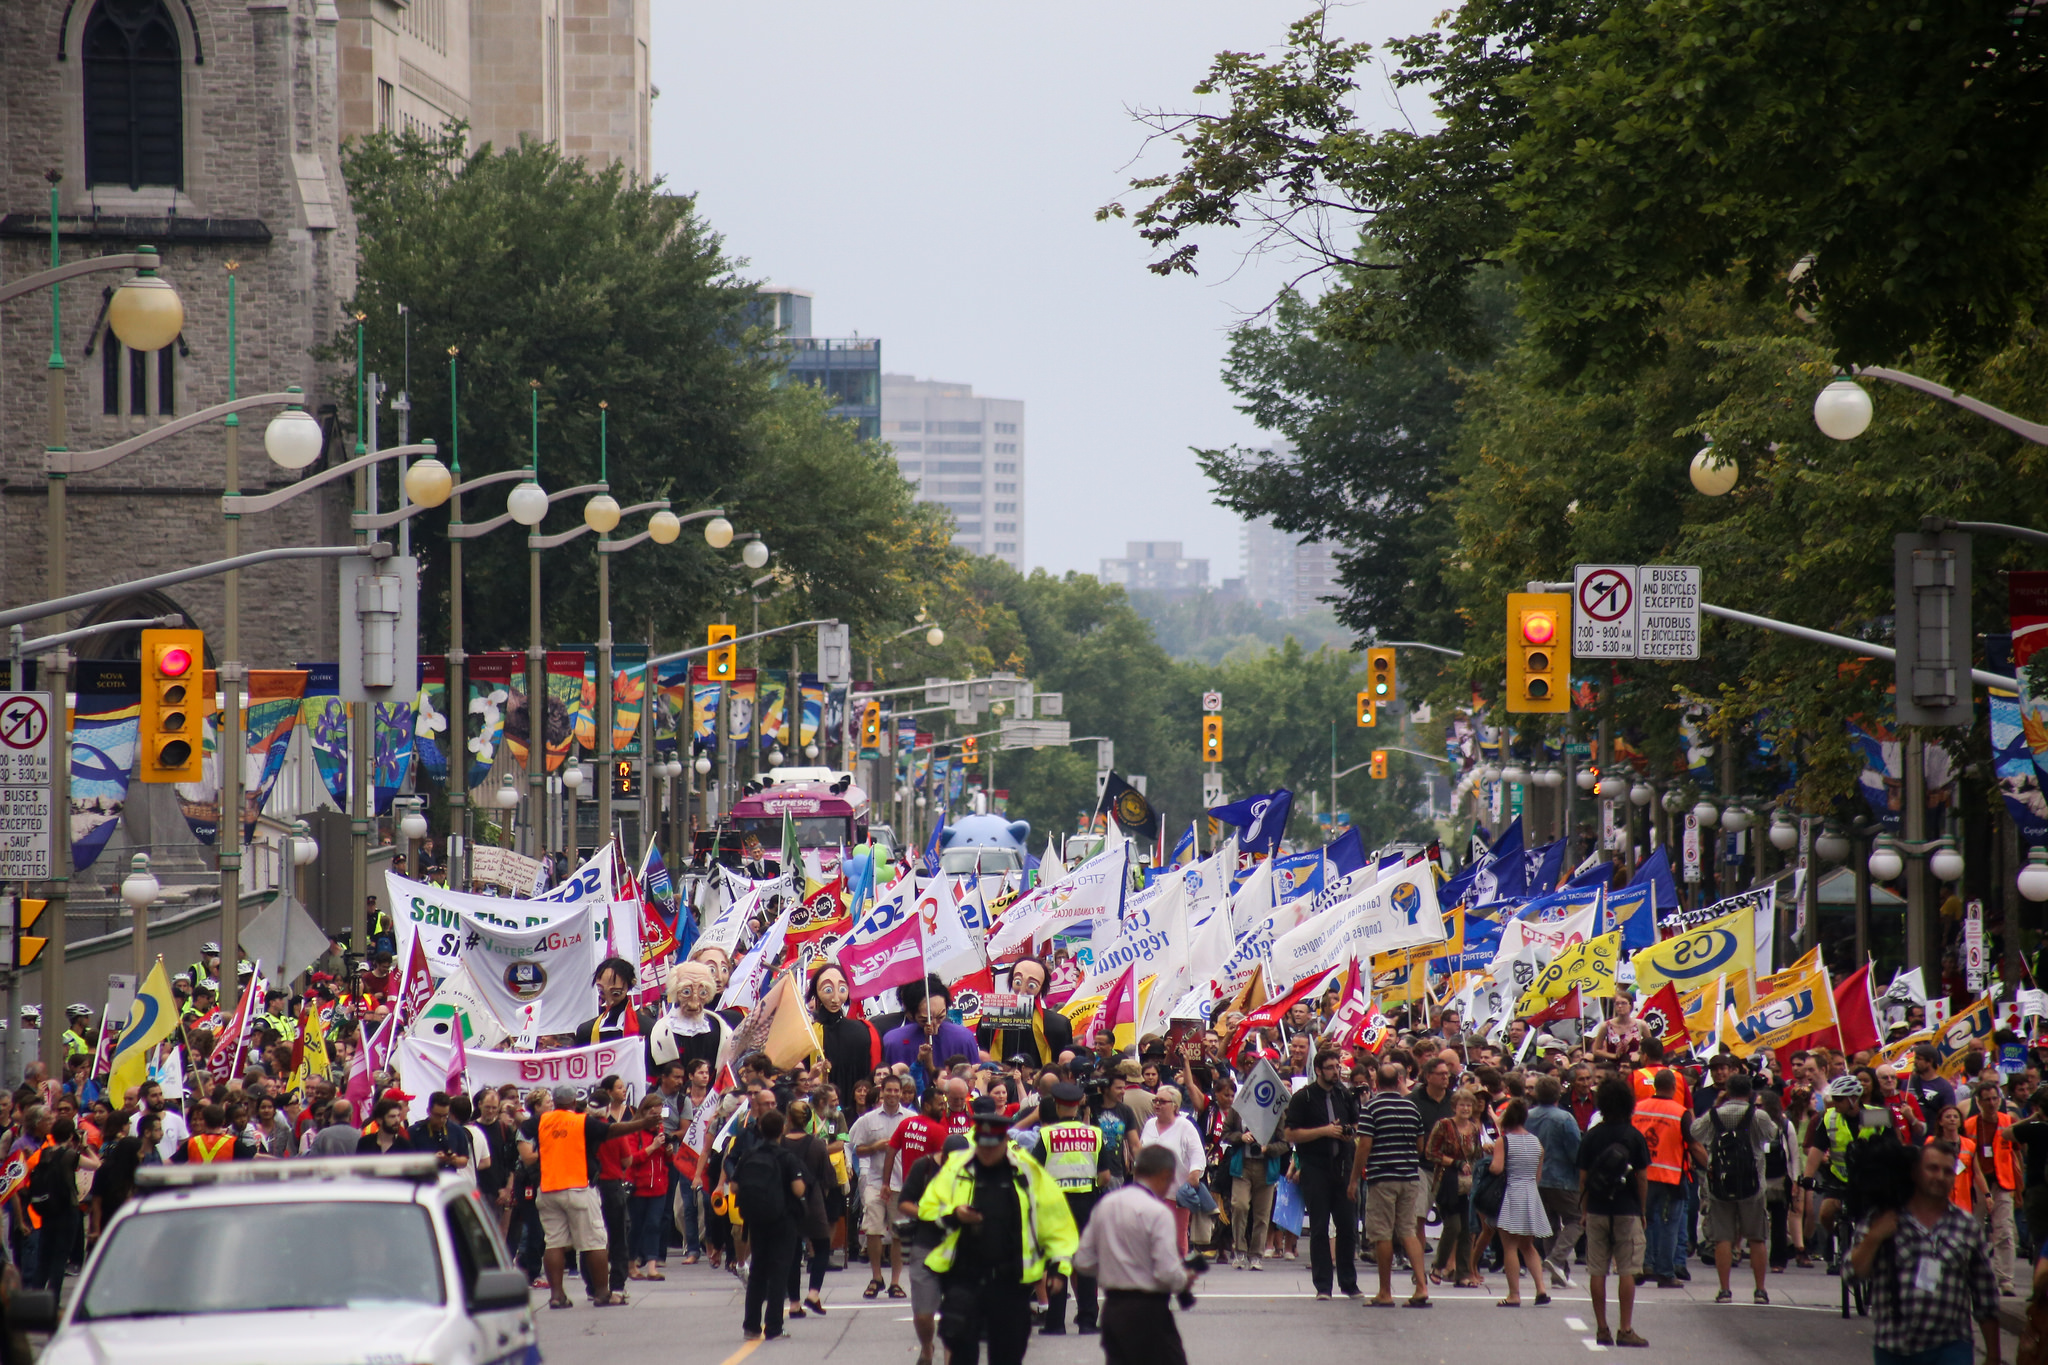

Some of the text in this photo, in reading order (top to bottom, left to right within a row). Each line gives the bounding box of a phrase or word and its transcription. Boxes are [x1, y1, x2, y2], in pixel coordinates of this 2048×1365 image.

[1652, 570, 1688, 582] BUSES
[1642, 584, 1697, 595] AND BICYCLES
[1644, 597, 1694, 608] EXCEPTED
[1647, 617, 1691, 628] AUTOBUS
[1578, 627, 1594, 638] 7:00
[1602, 627, 1619, 638] 9:00
[1642, 630, 1696, 641] ET BICYCLETTES
[1578, 641, 1594, 652] 3:30
[1602, 641, 1619, 652] 5:30
[17, 754, 34, 766] 9:00
[18, 768, 35, 781] 5:30
[4, 790, 38, 802] BUSES
[0, 804, 48, 816] ND BICYCLES
[0, 818, 42, 830] EXCEPTED
[10, 836, 31, 848] SAUF
[0, 851, 46, 862] UTOBUS ET
[0, 865, 47, 876] ICYCLETTES
[521, 1048, 616, 1081] STOP
[904, 1131, 927, 1142] services
[1052, 1129, 1095, 1139] POLICE
[1053, 1142, 1094, 1152] LIAISON
